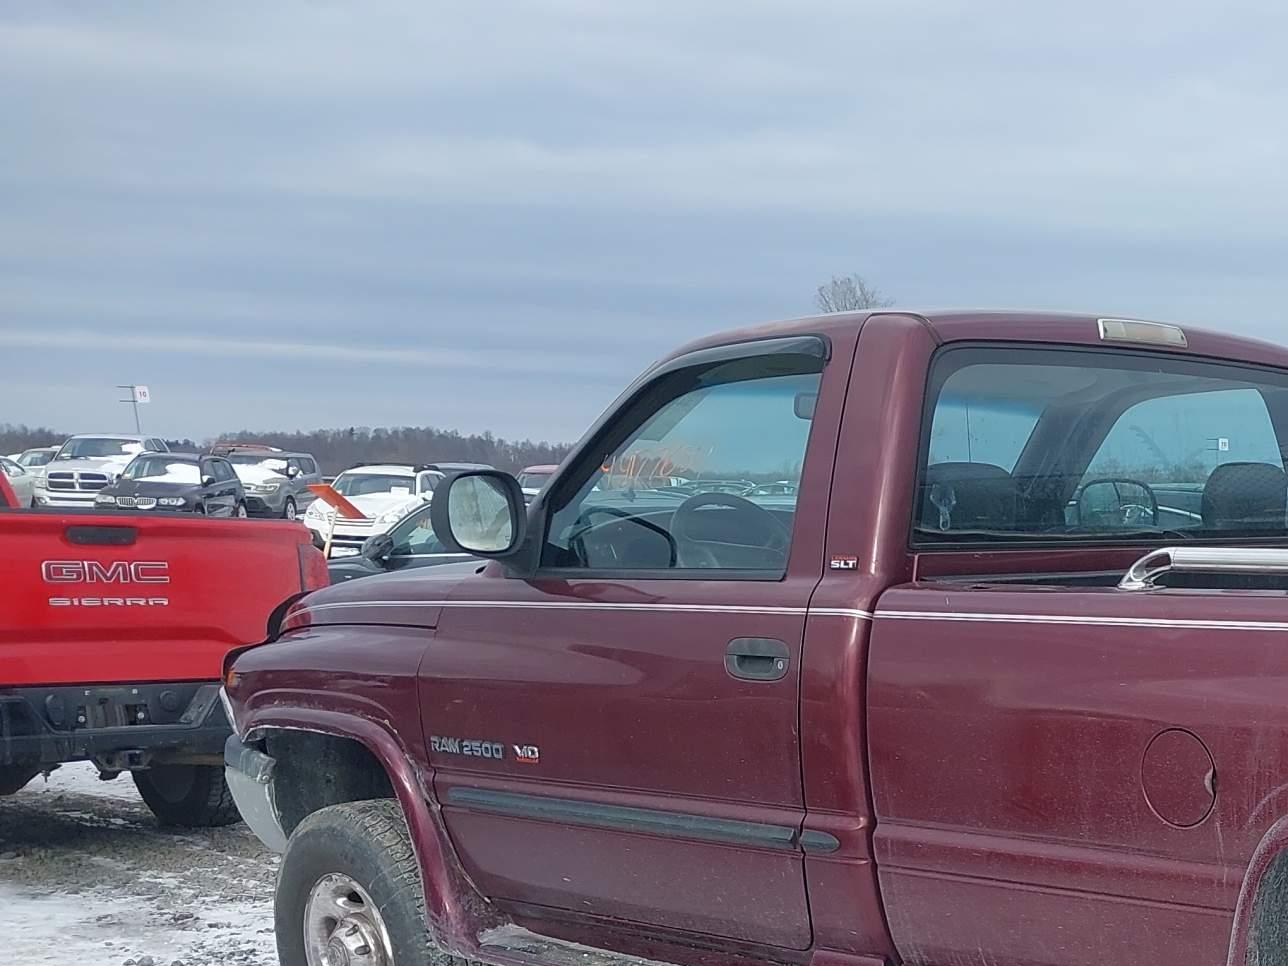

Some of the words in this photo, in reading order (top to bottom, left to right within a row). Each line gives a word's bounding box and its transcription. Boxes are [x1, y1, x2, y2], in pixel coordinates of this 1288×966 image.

[41, 560, 170, 583] GMC
[830, 560, 857, 569] SLT
[48, 597, 169, 606] SIERRA
[430, 735, 461, 754] RAM
[462, 739, 504, 760] 2500
